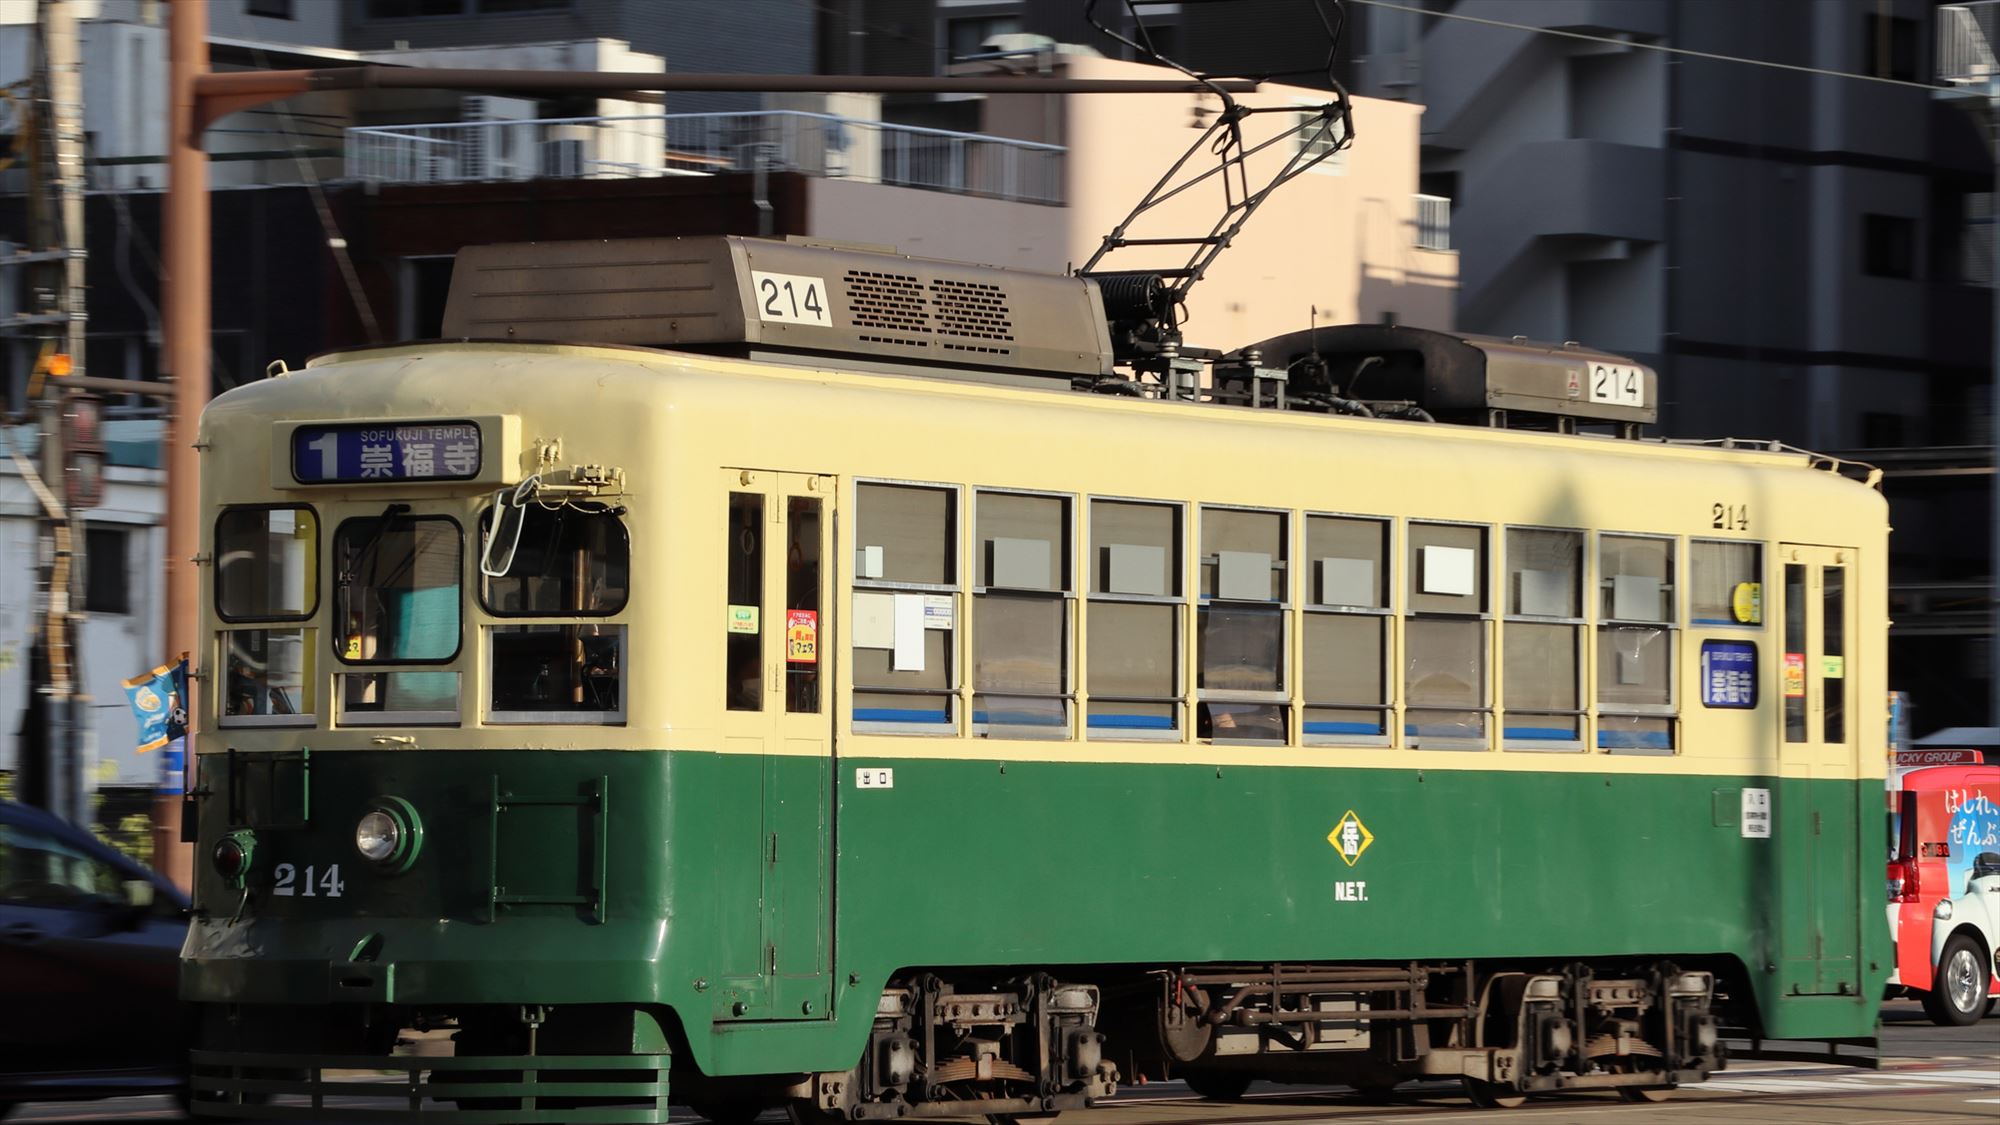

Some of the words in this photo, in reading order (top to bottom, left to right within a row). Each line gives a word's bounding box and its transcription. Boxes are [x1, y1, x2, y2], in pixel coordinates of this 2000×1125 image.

[761, 278, 823, 321] 214
[1595, 365, 1637, 401] 214
[360, 430, 423, 442] SOFUKUJI
[428, 427, 477, 440] TEMPLE
[308, 432, 338, 480] 1
[360, 442, 476, 478] 崇福寺
[1713, 502, 1748, 531] 214
[1924, 751, 1962, 763] GROUP
[1951, 818, 2000, 846] ぜんぶ
[273, 862, 345, 898] 214
